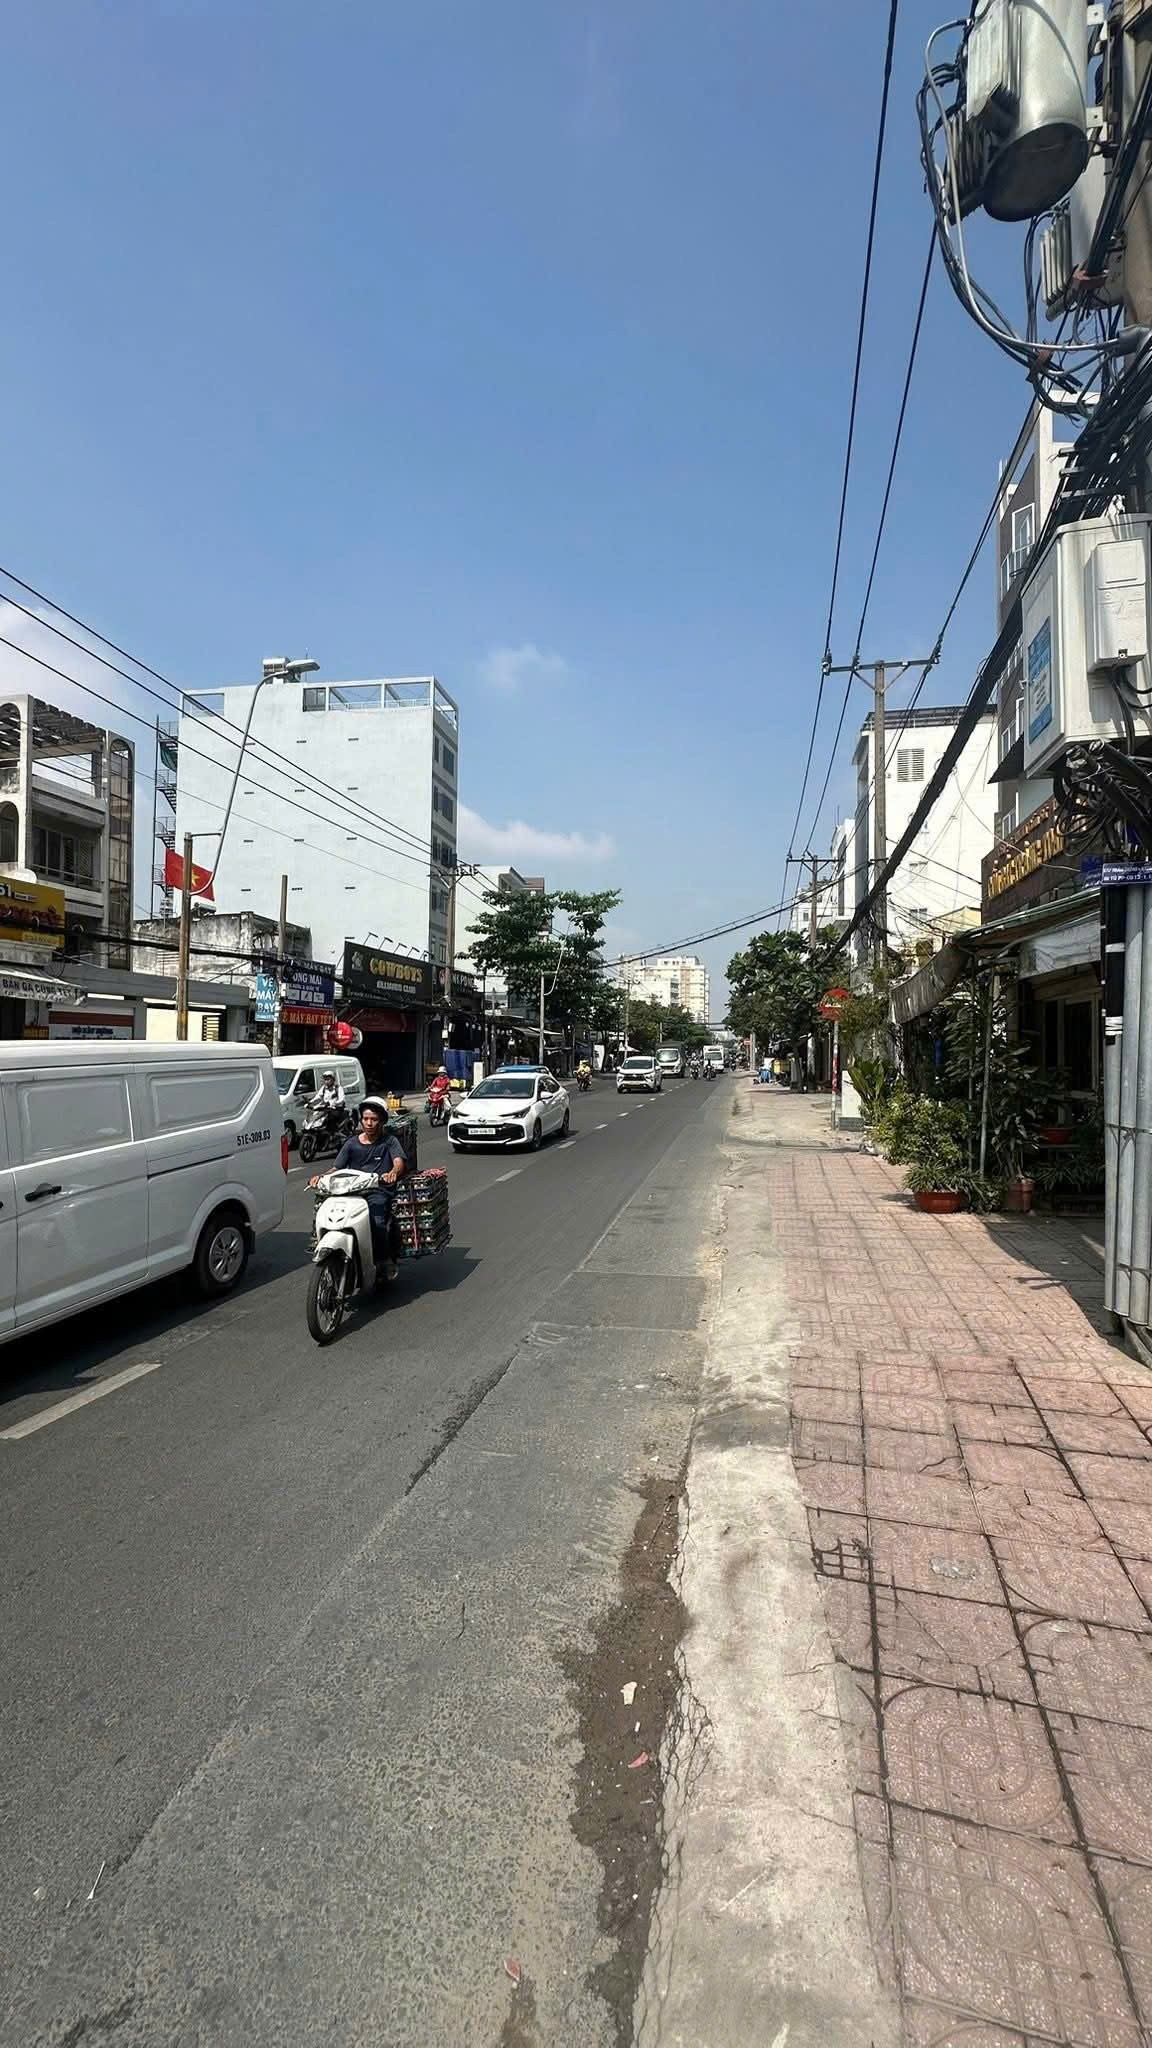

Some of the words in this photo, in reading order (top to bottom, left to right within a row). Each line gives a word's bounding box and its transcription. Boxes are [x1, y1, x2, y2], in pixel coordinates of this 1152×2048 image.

[369, 958, 423, 983] COWBOYS
[257, 1002, 276, 1013] BAY
[306, 1013, 318, 1024] BAY
